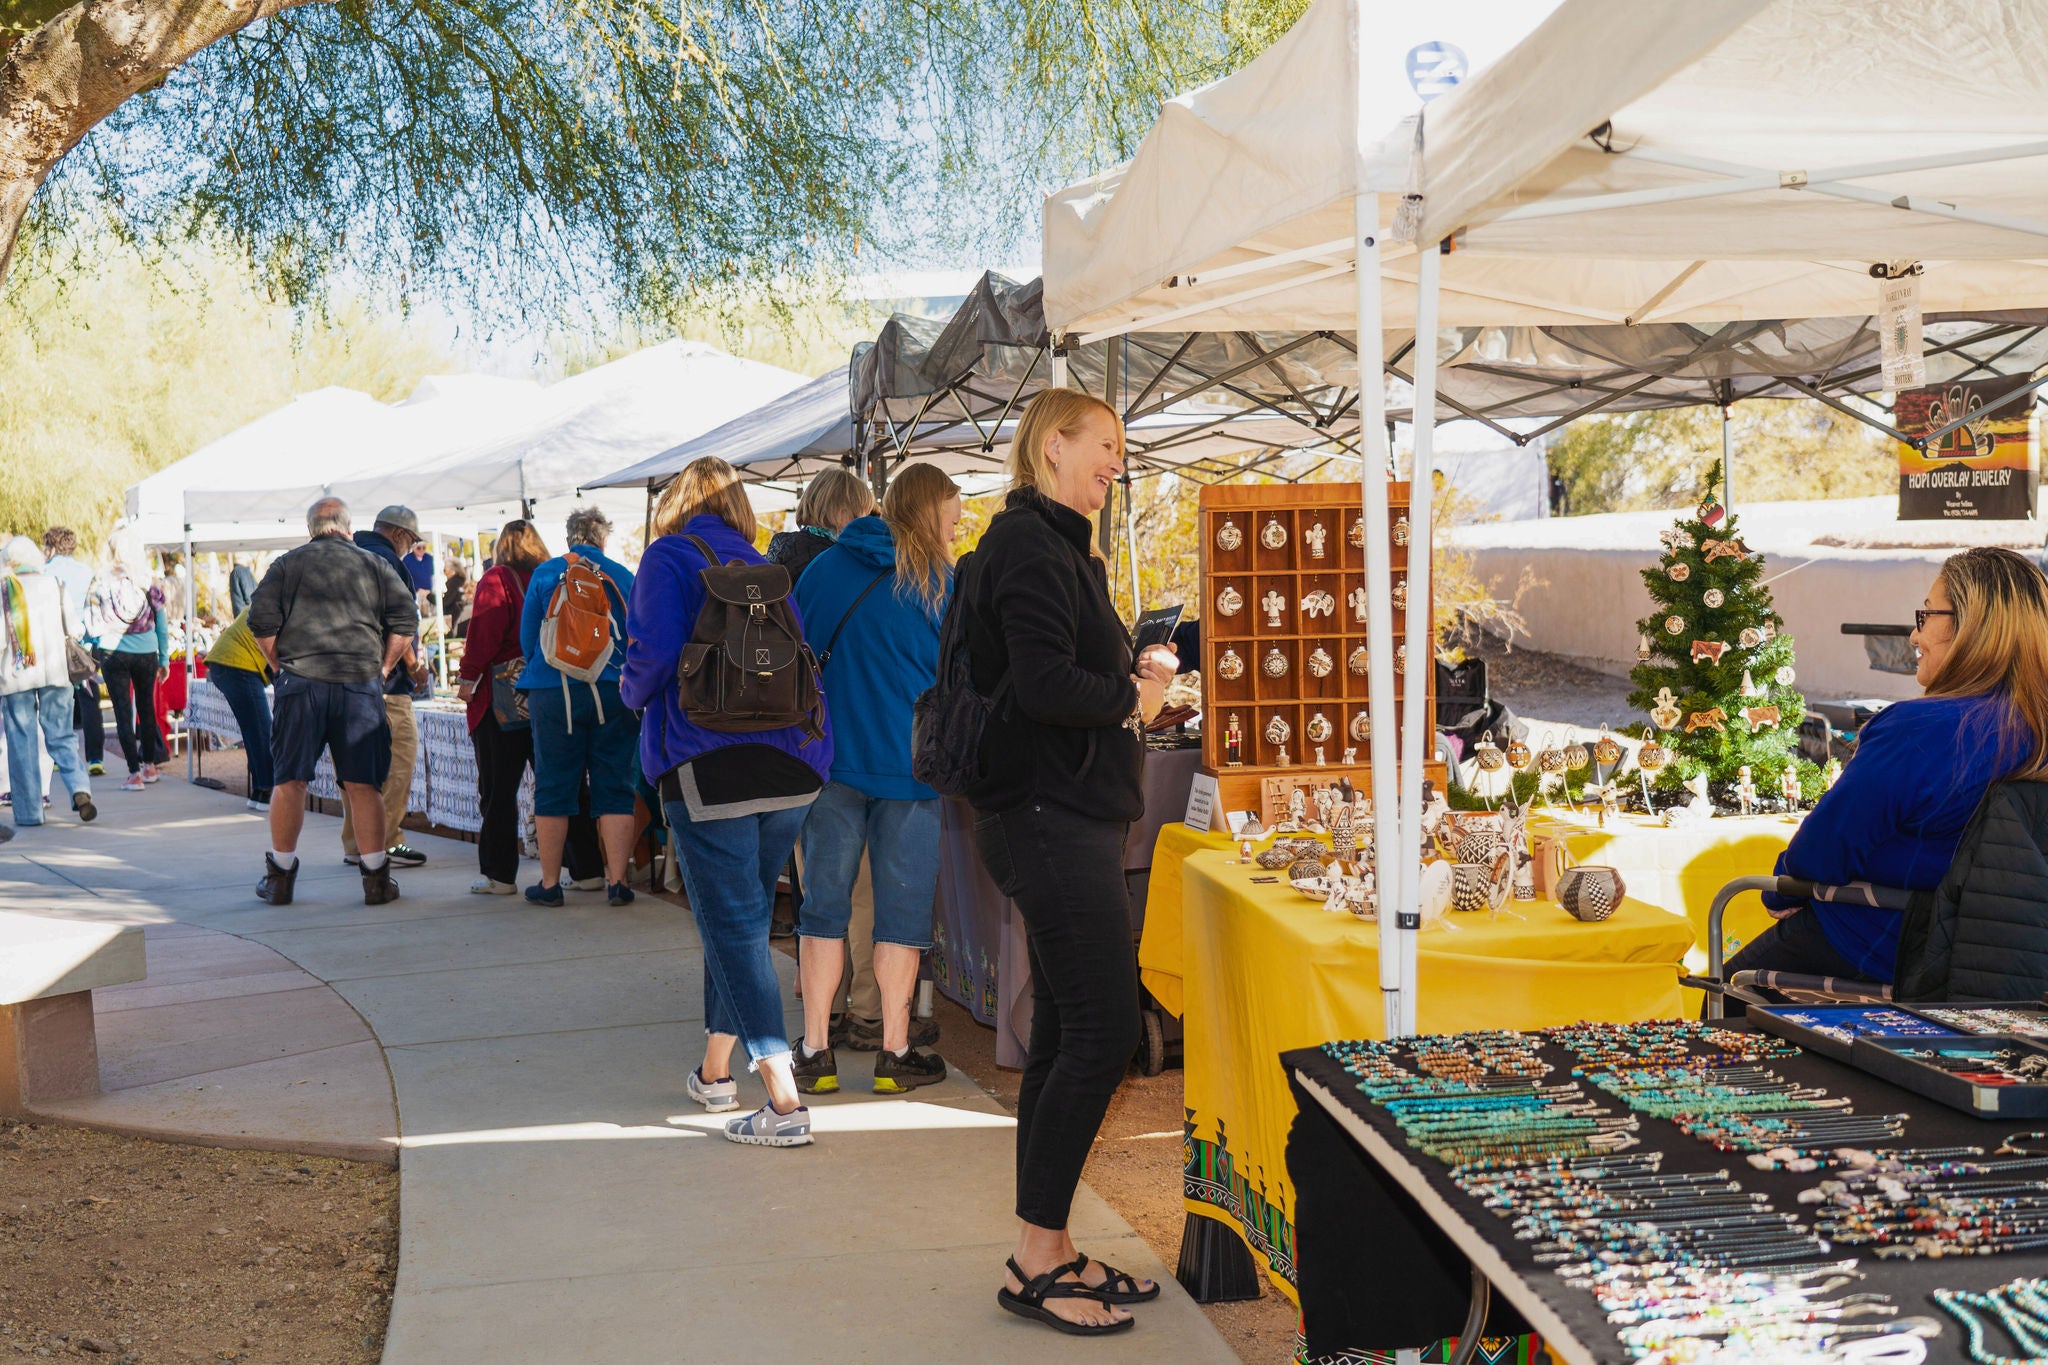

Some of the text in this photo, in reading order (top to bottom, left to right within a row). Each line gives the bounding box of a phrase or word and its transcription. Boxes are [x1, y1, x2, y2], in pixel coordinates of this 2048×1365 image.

[1895, 374, 1913, 385] POTTERY
[1909, 469, 2012, 489] HOPI OVERLAY JEWELRY
